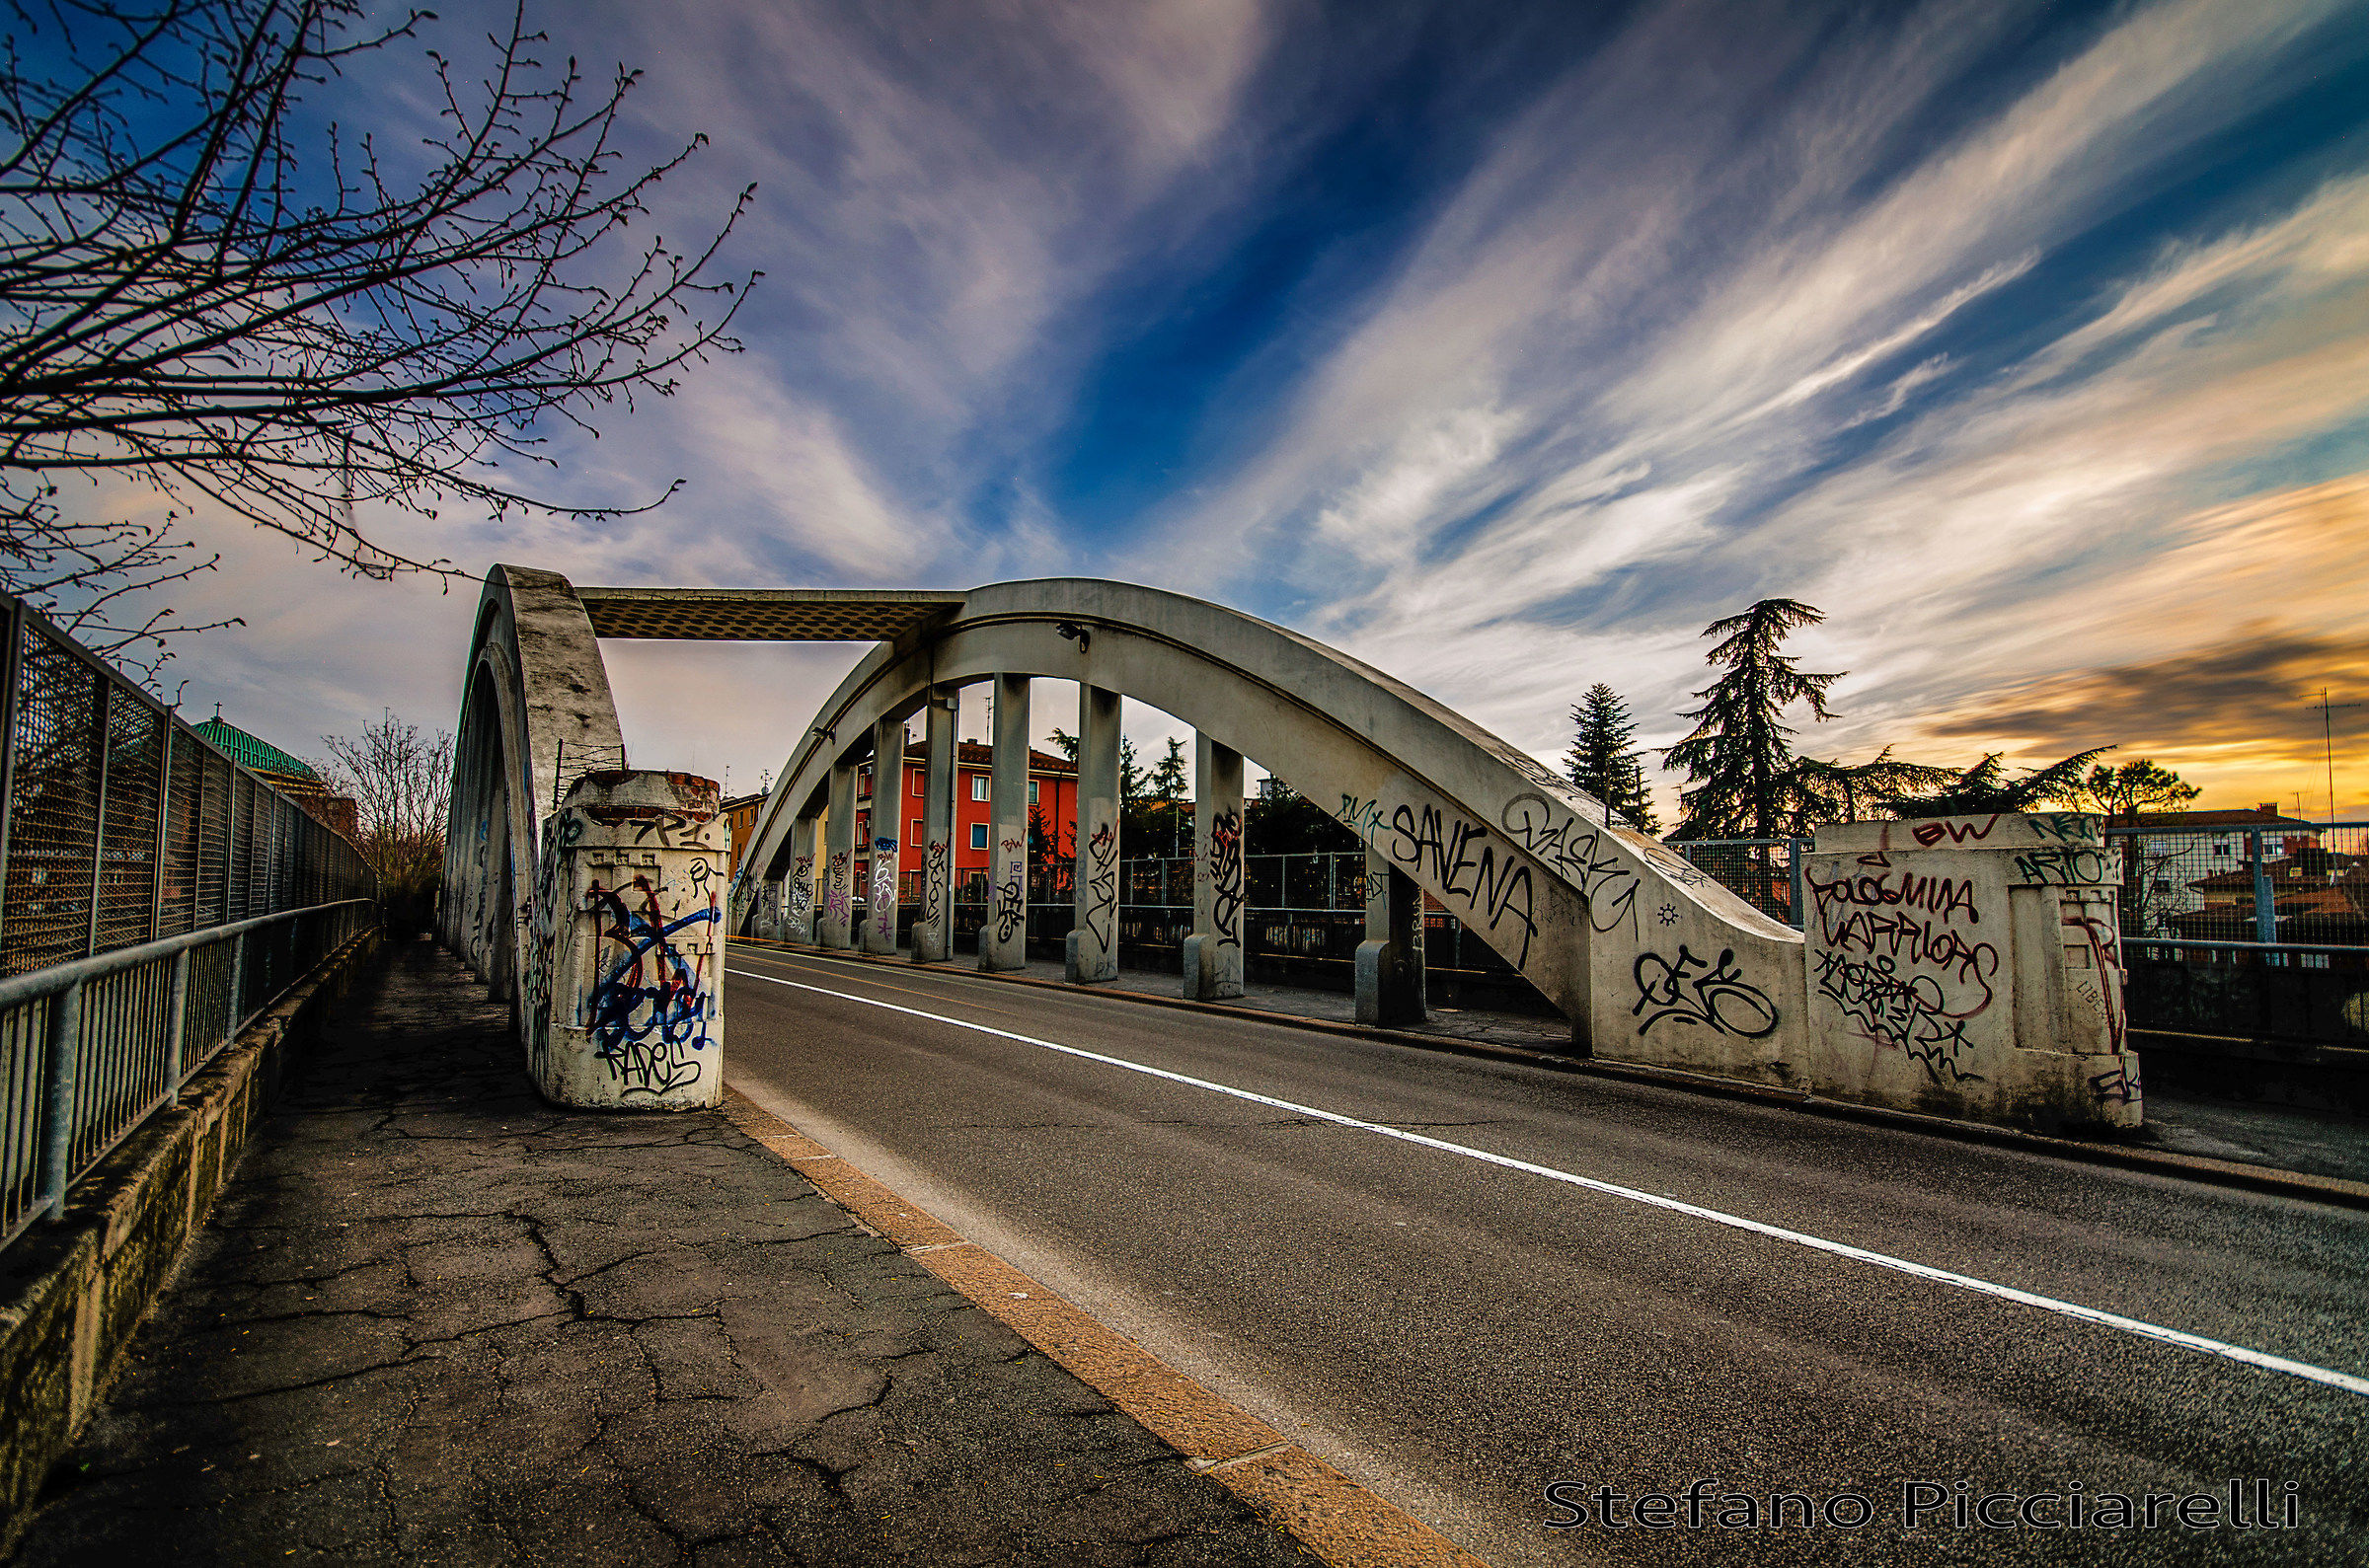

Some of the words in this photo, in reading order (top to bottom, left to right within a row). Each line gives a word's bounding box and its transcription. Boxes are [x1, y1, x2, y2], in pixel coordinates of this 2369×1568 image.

[1000, 828, 1027, 853] BW
[1912, 814, 2001, 848] BW
[1392, 803, 1539, 971] SAVENA
